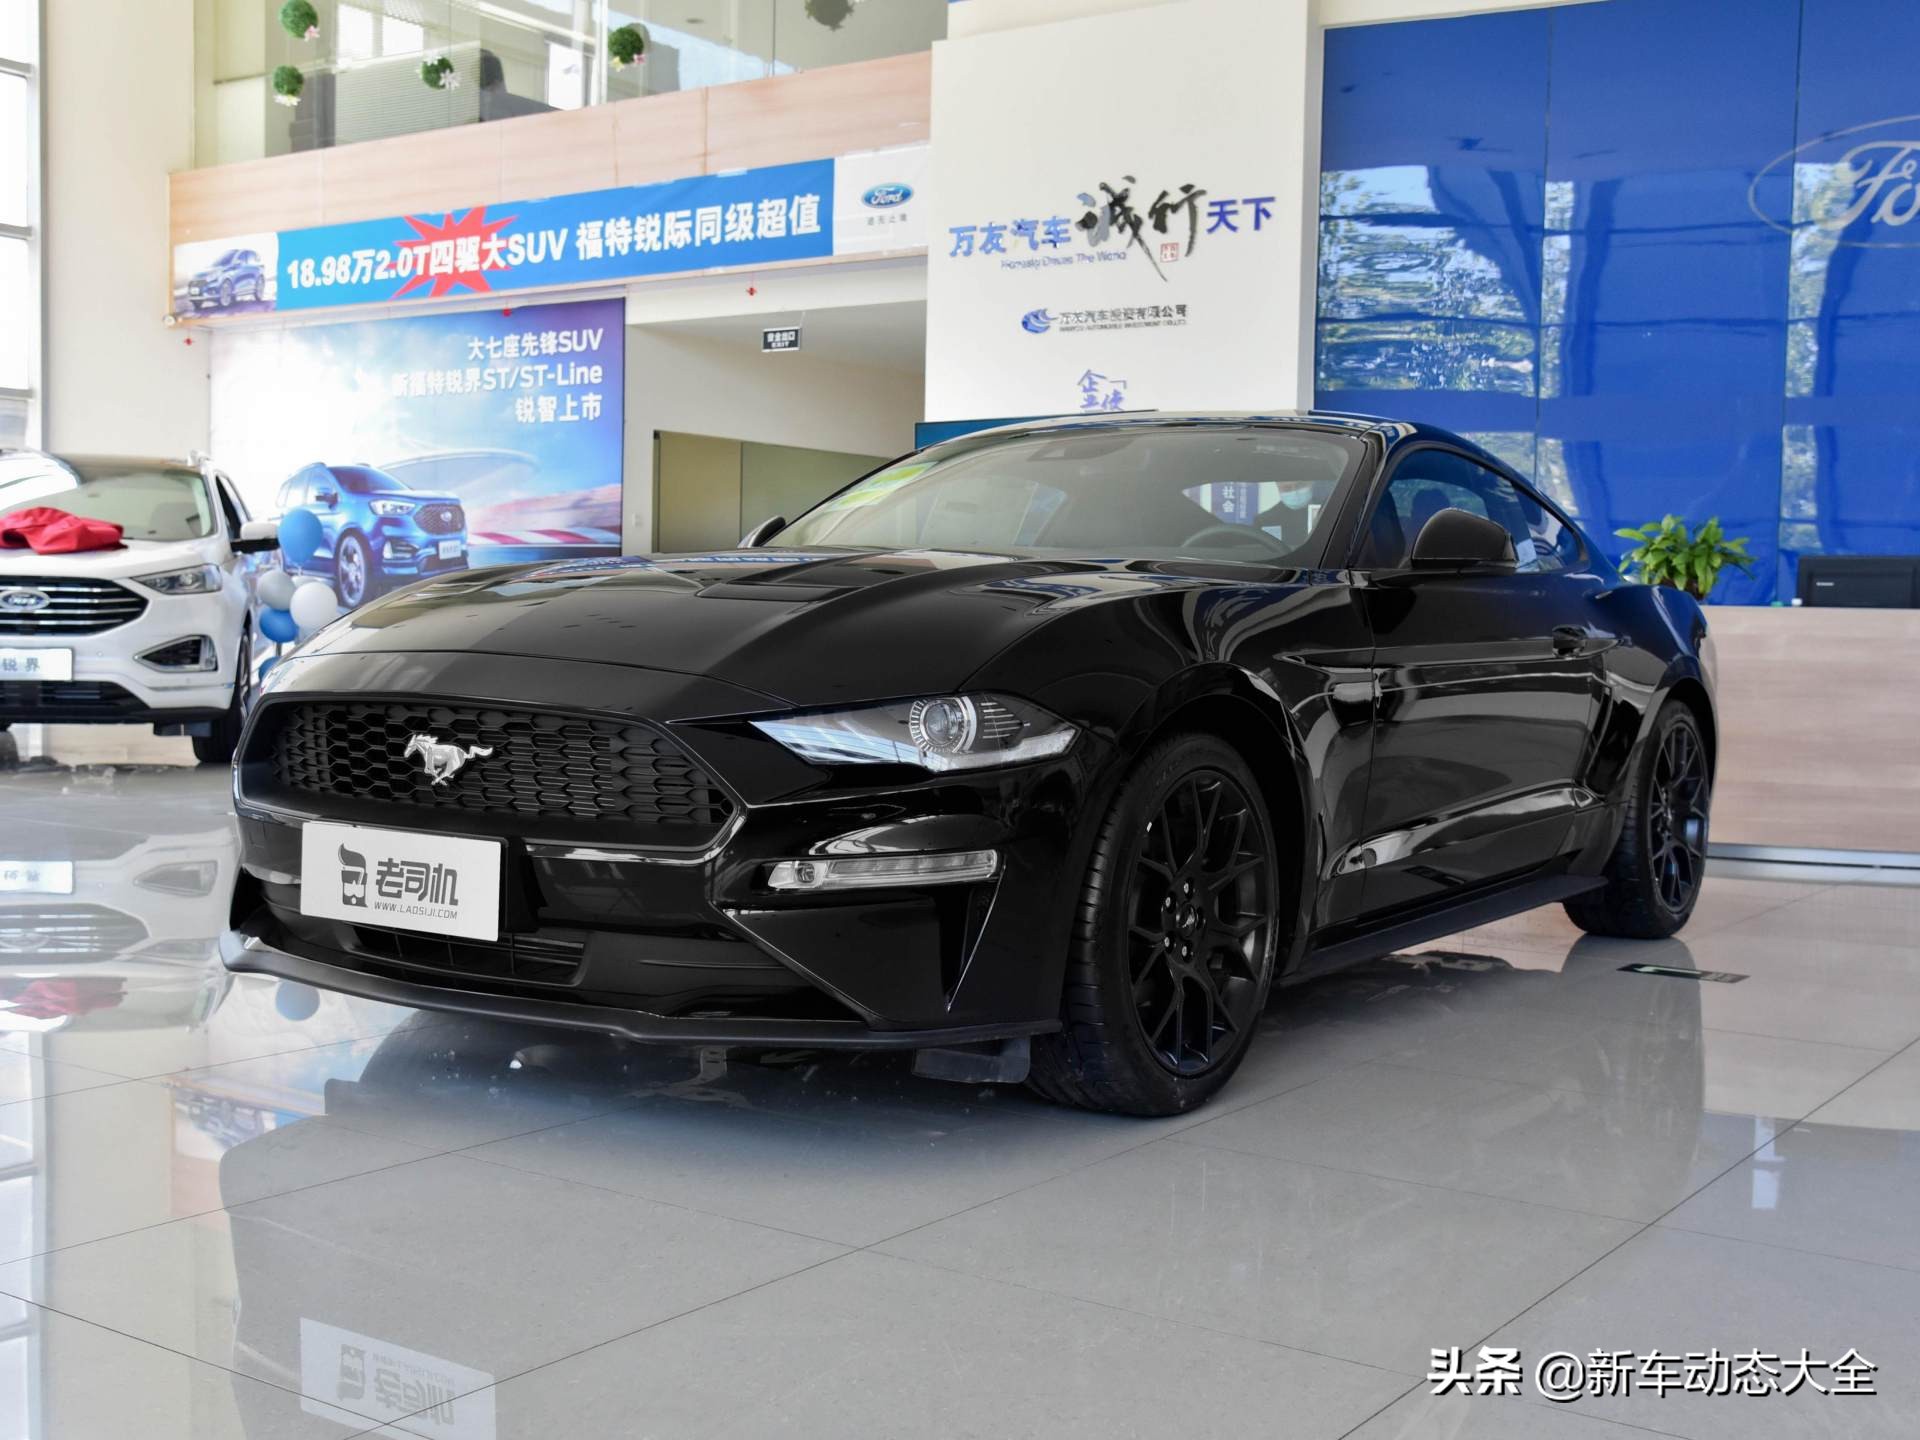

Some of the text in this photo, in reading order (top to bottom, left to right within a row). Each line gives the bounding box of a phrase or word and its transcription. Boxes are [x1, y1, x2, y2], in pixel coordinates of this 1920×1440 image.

[287, 193, 821, 289] 18.98万2.0T四驱大SUV 福特锐际同级超值
[1076, 253, 1095, 263] The
[468, 328, 604, 361] 大七座先锋SUV
[391, 361, 603, 398] 新福特锐界ST/ST-Line
[515, 392, 603, 423] 锐智上市
[375, 857, 459, 906] 老司机
[374, 901, 458, 920] WWW.LAOSIJI.COM
